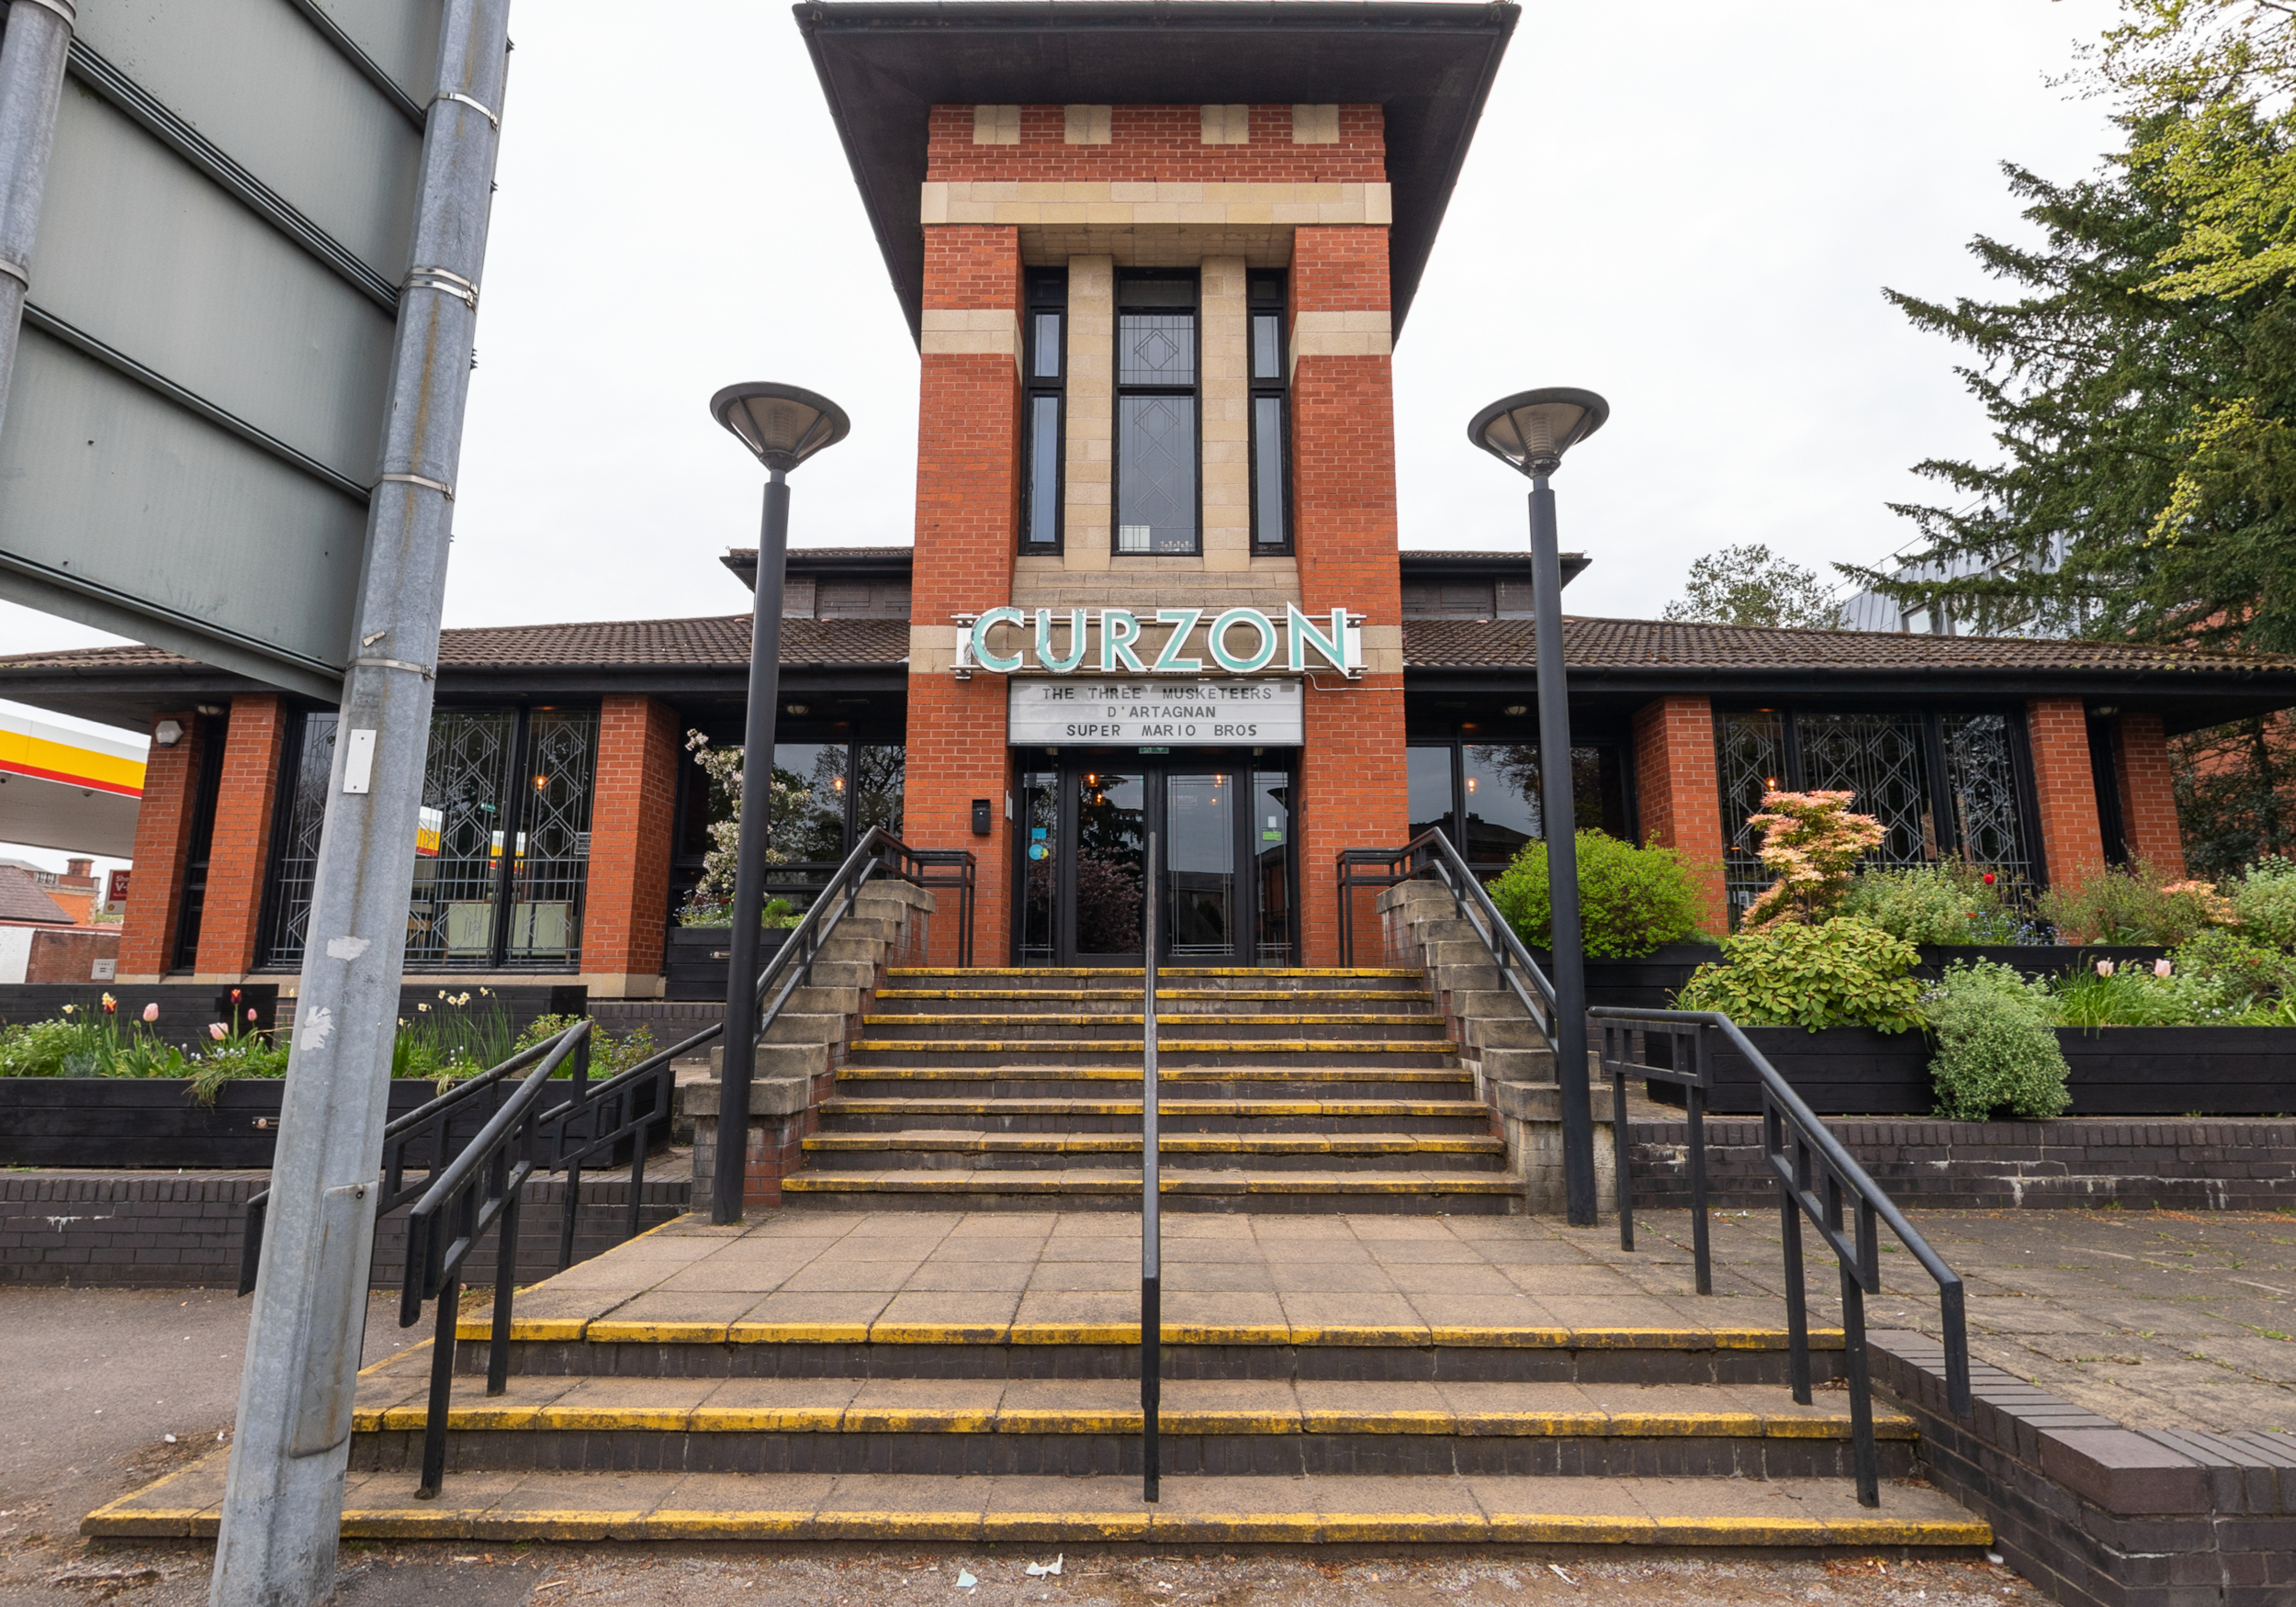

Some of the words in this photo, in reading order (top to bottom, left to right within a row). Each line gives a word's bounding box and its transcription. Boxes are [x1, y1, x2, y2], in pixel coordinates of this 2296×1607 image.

[971, 601, 1349, 678] CURZON
[1042, 688, 1075, 700] THE
[1088, 688, 1142, 700] THREE
[1163, 688, 1272, 700] MUSKETEERS
[1108, 706, 1216, 718] D'ARTAGNAN
[1067, 725, 1120, 736] SUPER
[1142, 725, 1196, 736] MARIO
[1214, 725, 1257, 736] BROS
